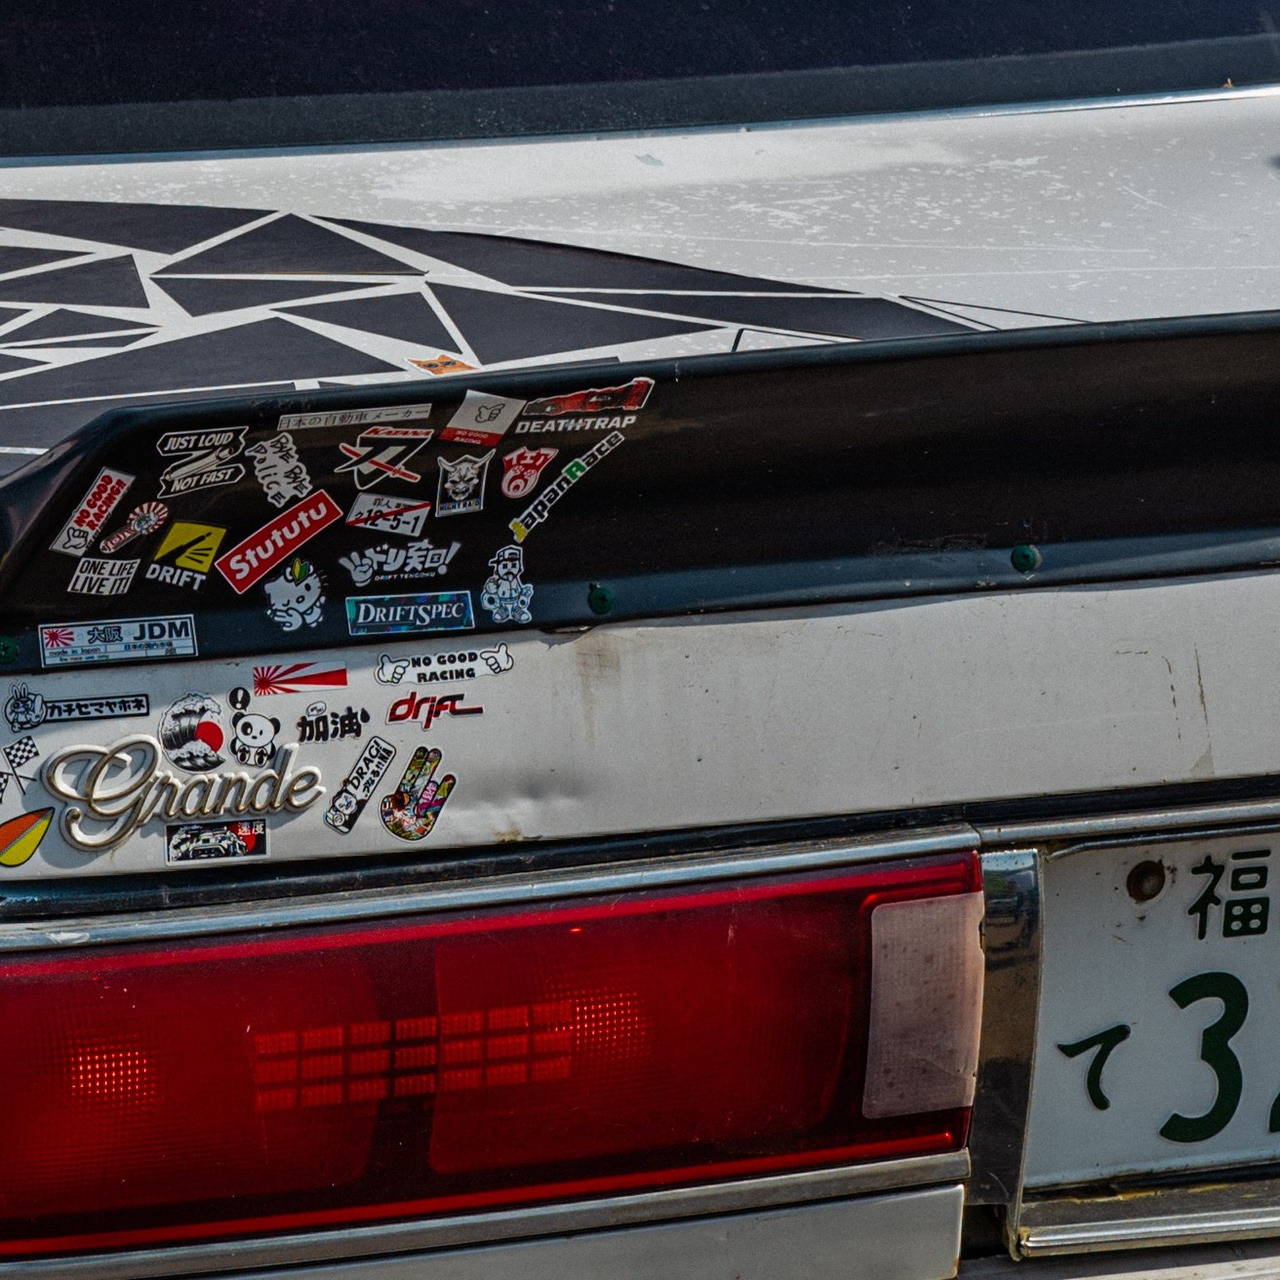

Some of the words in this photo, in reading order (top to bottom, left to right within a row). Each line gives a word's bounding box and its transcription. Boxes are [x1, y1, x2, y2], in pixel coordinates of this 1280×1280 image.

[278, 408, 431, 429] 日本の自動車メーカー
[164, 434, 198, 451] JUST
[198, 432, 234, 448] LOUD
[171, 475, 199, 493] NOT
[200, 469, 235, 487] FAST
[73, 510, 92, 528] NO
[86, 474, 113, 510] GOOD
[228, 501, 329, 580] Stututu
[78, 559, 110, 576] ONE
[111, 560, 137, 576] LIFE
[145, 563, 208, 591] DRIFT
[70, 577, 107, 595] LIVE
[107, 577, 133, 595] IT!
[88, 626, 124, 643] 大阪
[133, 621, 190, 641] JDM
[411, 655, 432, 668] NO
[436, 652, 479, 665] GOOD
[416, 668, 476, 683] RACING
[298, 705, 365, 742] 加油
[388, 691, 484, 729] drift
[349, 739, 381, 789] DRAG!
[41, 734, 326, 850] Grande
[1187, 848, 1272, 940] 福
[1056, 1024, 1132, 1111] て
[1159, 972, 1280, 1144] 3
